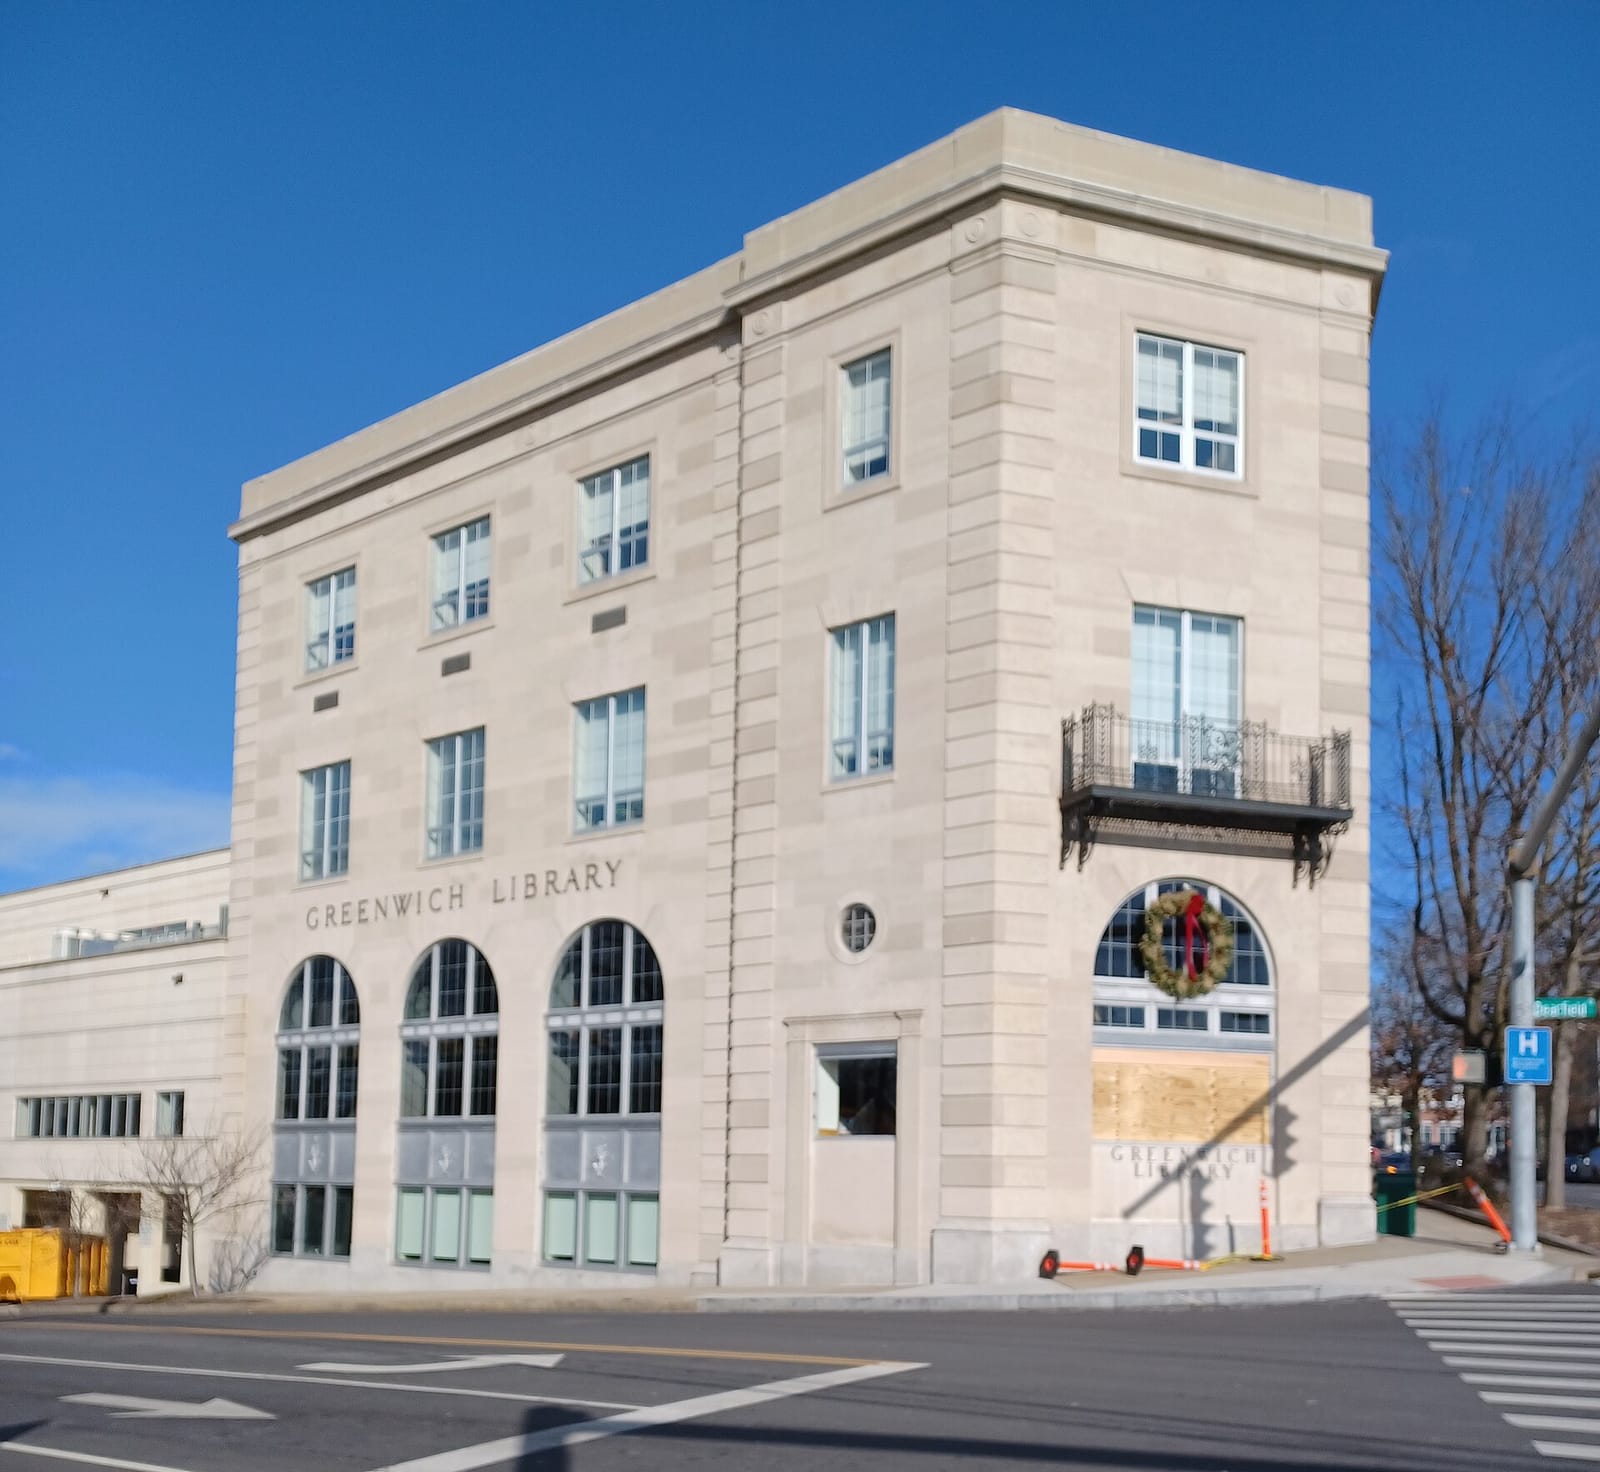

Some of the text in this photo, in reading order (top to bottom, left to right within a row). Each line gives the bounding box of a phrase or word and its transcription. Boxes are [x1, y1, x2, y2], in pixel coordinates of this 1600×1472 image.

[306, 859, 622, 930] GREENWICH LIBRARY
[1519, 1032, 1538, 1056] H
